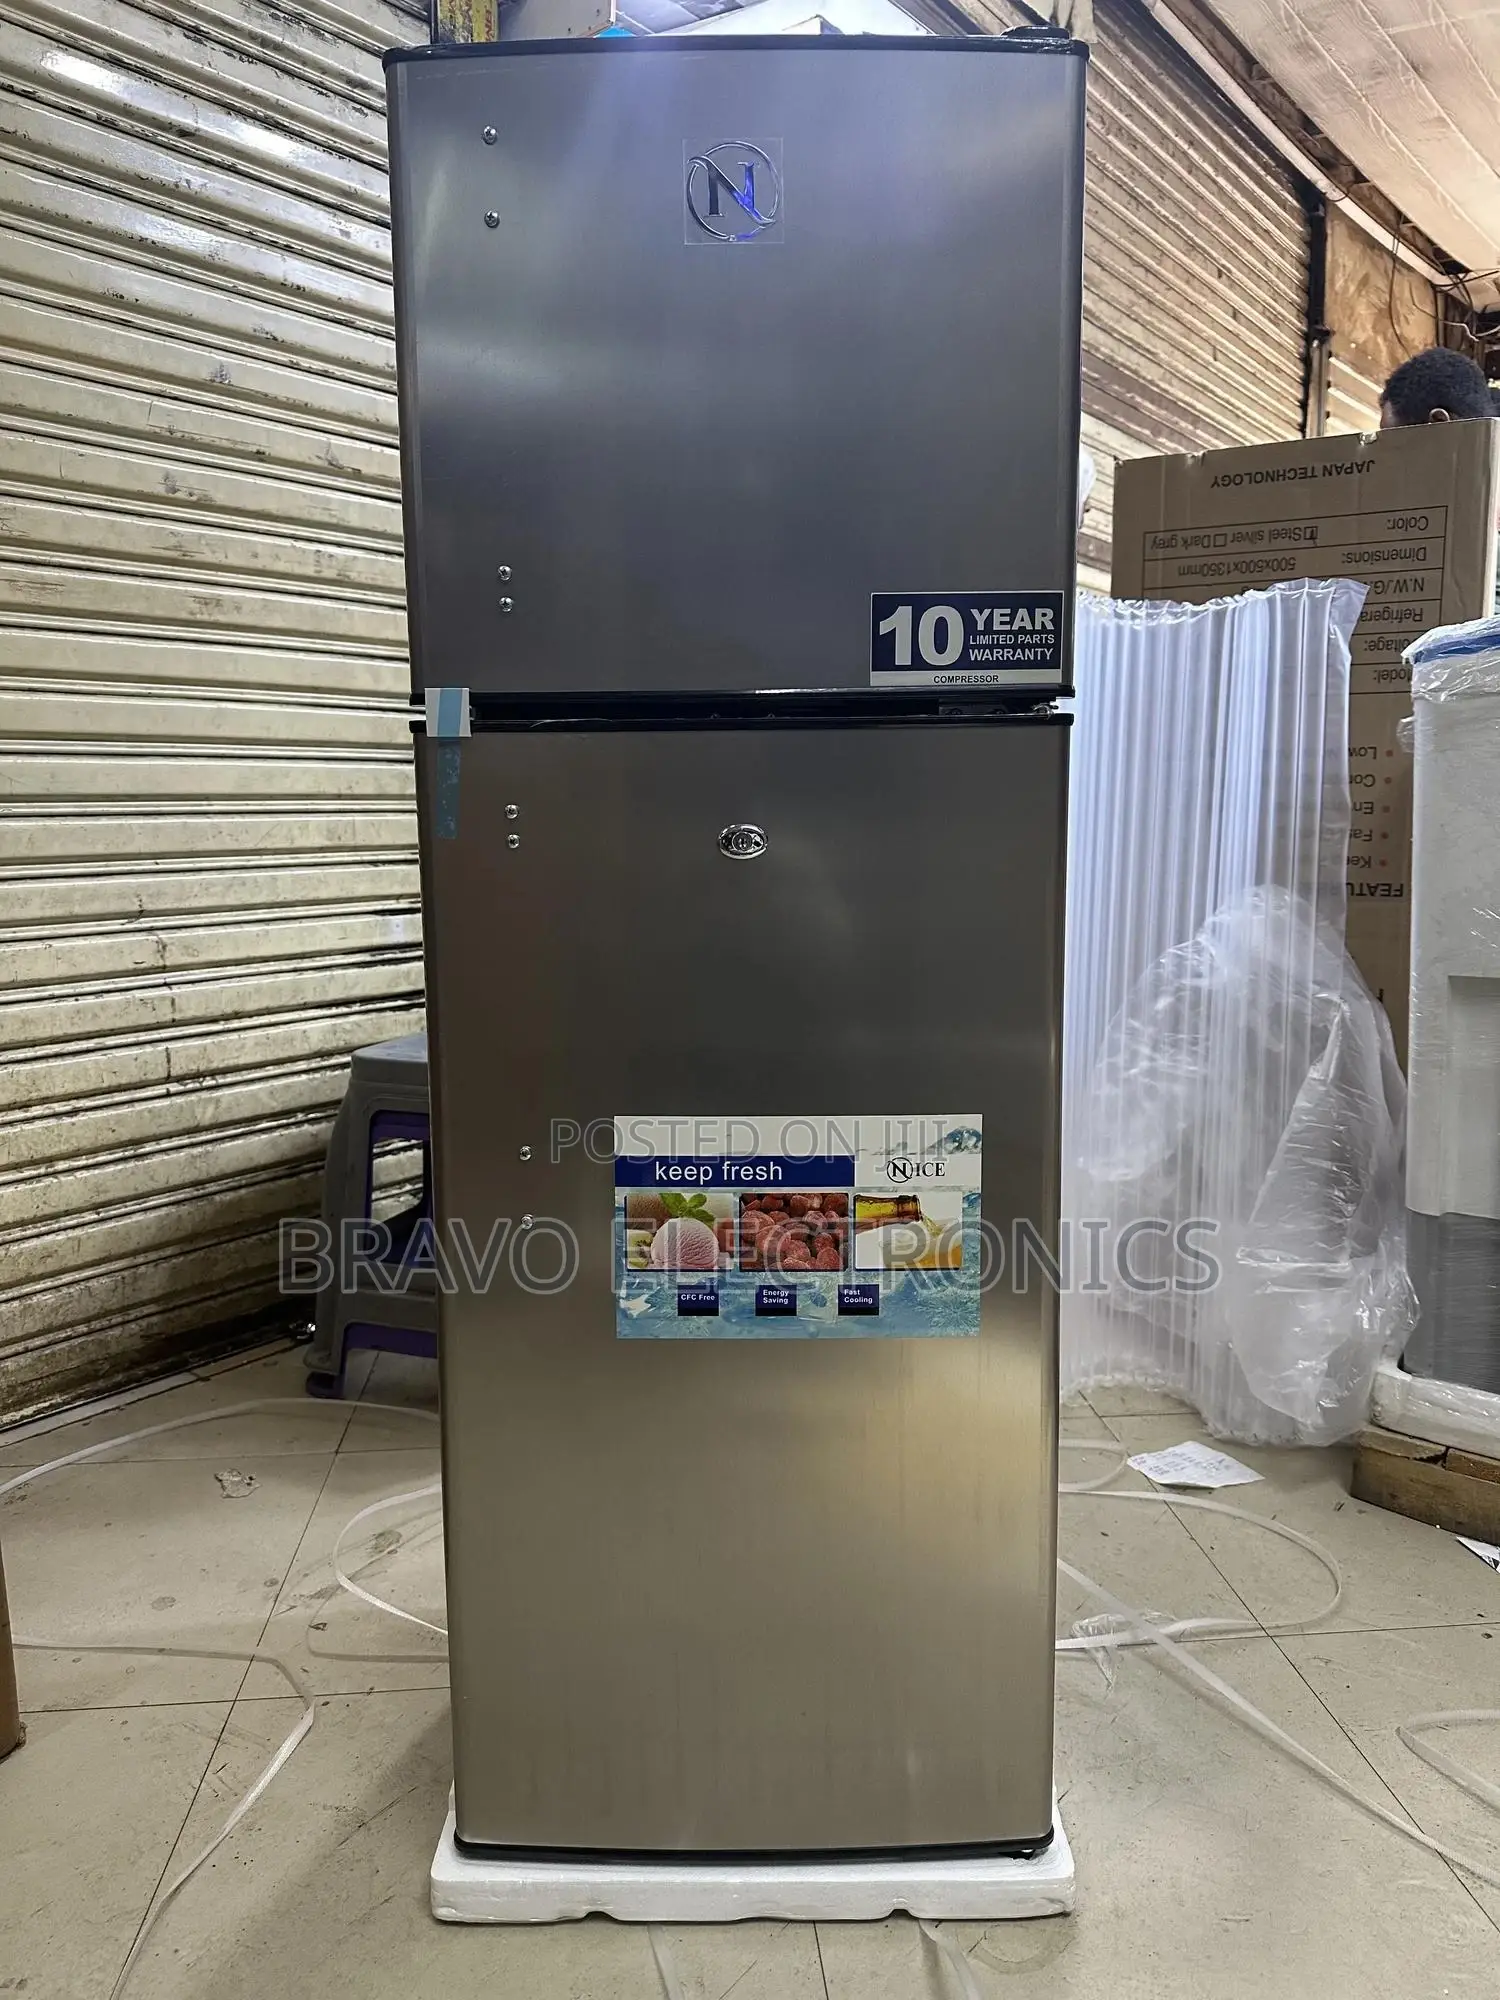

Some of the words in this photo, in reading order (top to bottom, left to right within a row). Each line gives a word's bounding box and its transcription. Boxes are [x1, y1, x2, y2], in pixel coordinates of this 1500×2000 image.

[1322, 459, 1375, 477] JAPAN
[1211, 466, 1318, 488] TECHNOLOGY
[1387, 515, 1429, 531] Color:
[1181, 533, 1213, 548] Dark
[1230, 529, 1264, 544] silver
[1269, 526, 1302, 541] Steel
[1151, 535, 1179, 550] grey
[1342, 547, 1427, 564] Dimensions:
[1178, 556, 1296, 577] 500x500x1350mm
[1366, 577, 1425, 595] N.W./G.
[1360, 606, 1424, 624] Refrigera
[879, 605, 964, 666] 10
[970, 608, 1055, 631] YEAR
[969, 635, 1014, 645] LIMITED
[1017, 634, 1055, 644] PARTS
[1364, 635, 1409, 653] oltage:
[969, 648, 1054, 661] WARRANTY
[933, 675, 999, 684] COMPRESSOR
[1352, 801, 1374, 814] En
[1345, 883, 1403, 897] FEATU
[655, 1162, 713, 1184] keep
[722, 1161, 783, 1181] fresh
[680, 1293, 696, 1301] CFC
[698, 1293, 715, 1301] Free
[763, 1289, 789, 1298] Energy
[763, 1296, 789, 1305] Saving
[844, 1289, 860, 1297] Fast
[844, 1296, 873, 1305] Cooling
